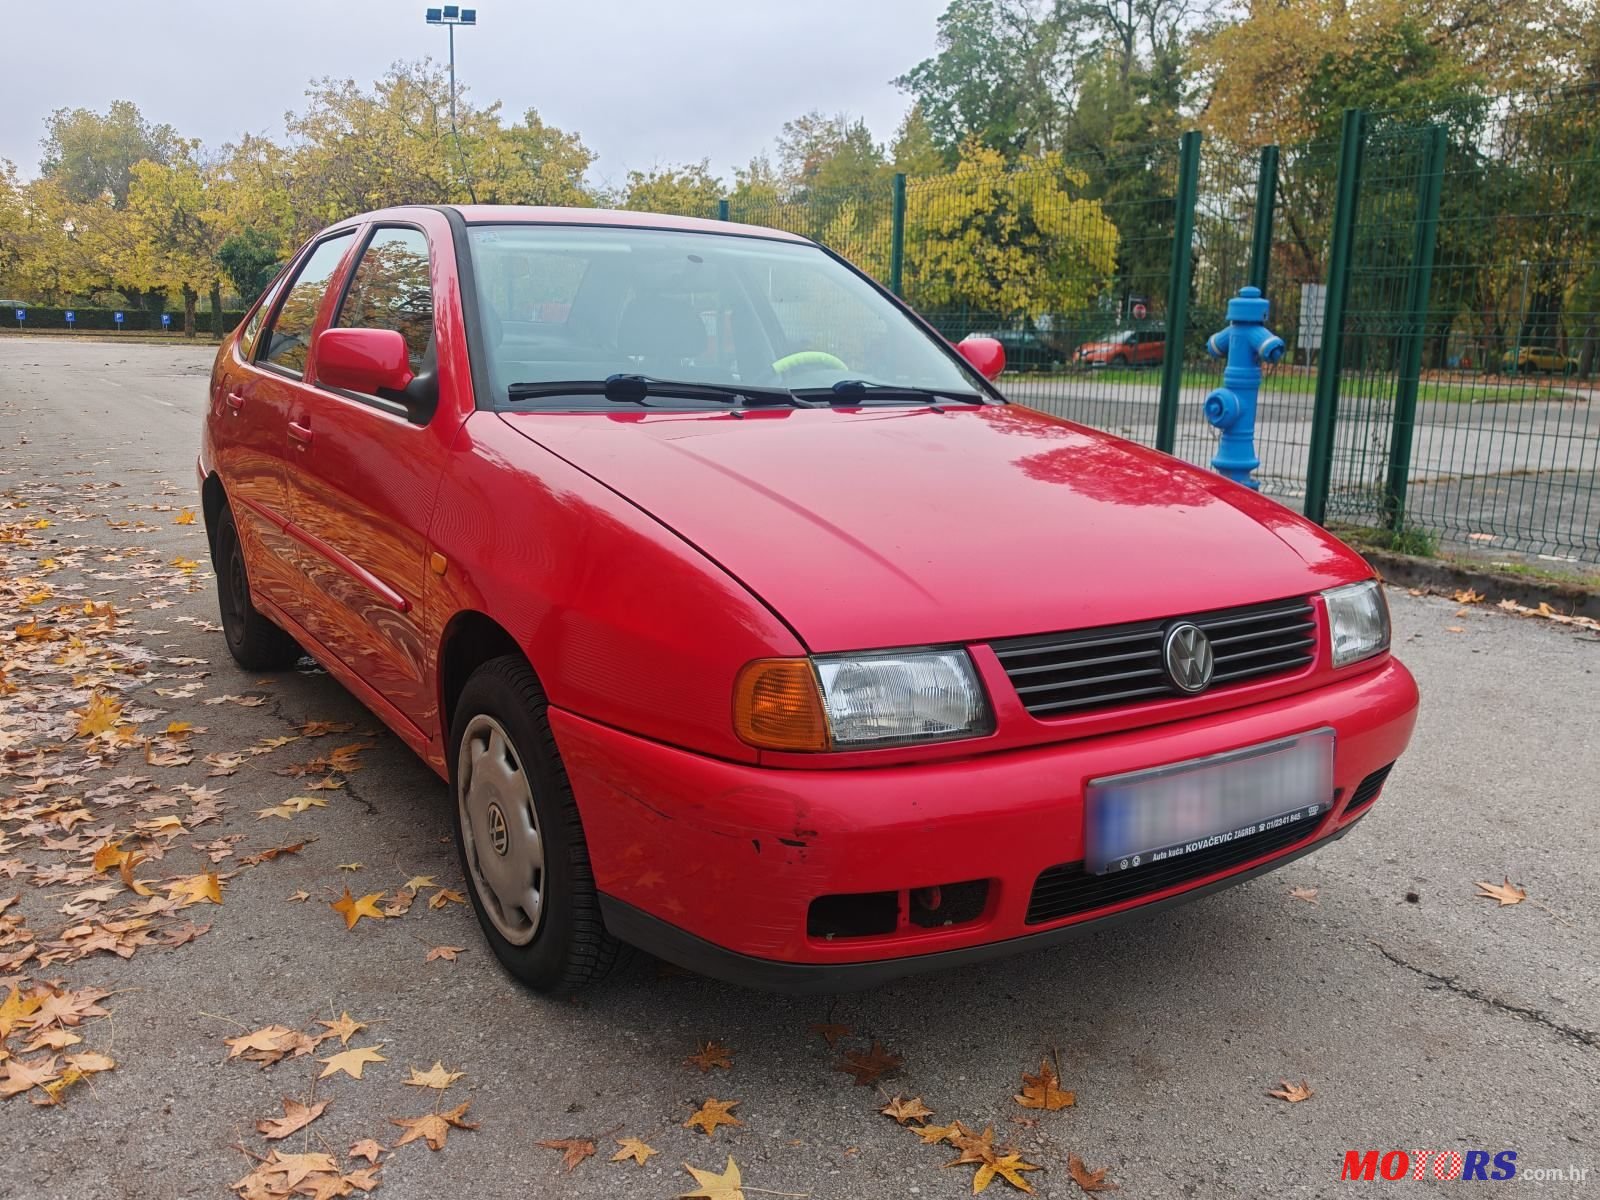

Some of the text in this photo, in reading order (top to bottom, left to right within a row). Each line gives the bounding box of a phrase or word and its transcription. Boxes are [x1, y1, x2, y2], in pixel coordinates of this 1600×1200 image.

[1167, 624, 1213, 692] VW
[1152, 852, 1167, 862] Auto
[1234, 825, 1256, 840] ZAGREB
